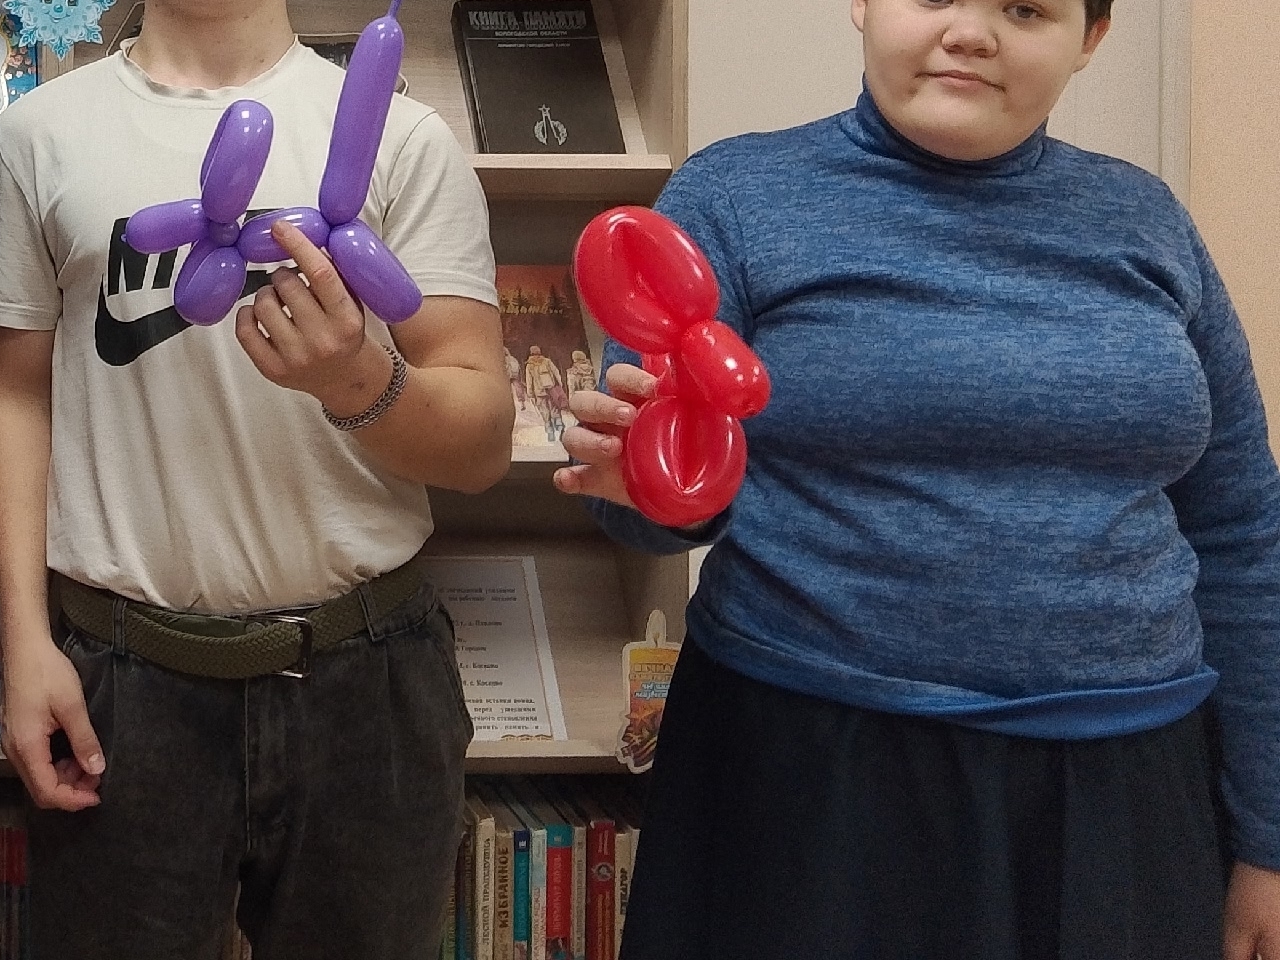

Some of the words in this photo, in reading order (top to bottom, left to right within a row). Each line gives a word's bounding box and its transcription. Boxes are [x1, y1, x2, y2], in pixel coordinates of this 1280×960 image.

[468, 11, 519, 30] КНИГА
[523, 11, 586, 30] ПАМЯТИ
[498, 847, 509, 928] ИЗБРАННОЕ
